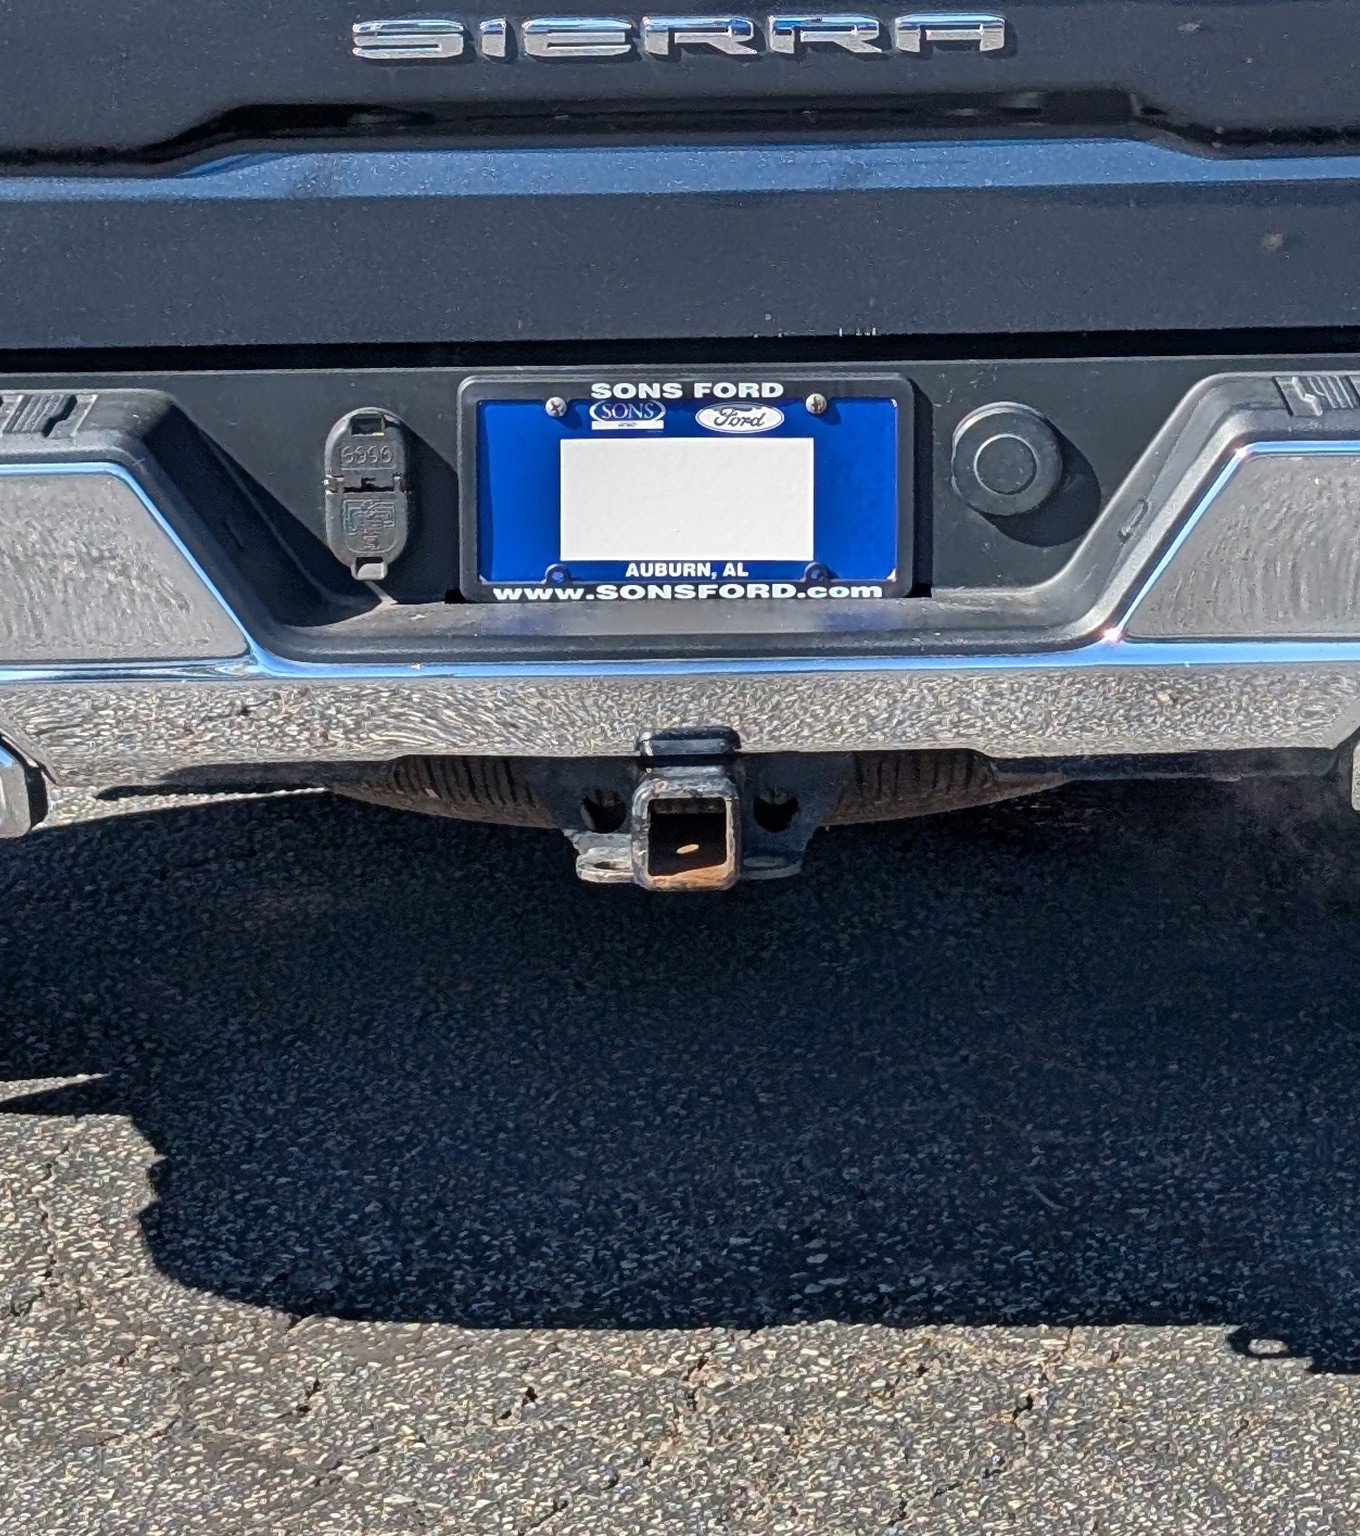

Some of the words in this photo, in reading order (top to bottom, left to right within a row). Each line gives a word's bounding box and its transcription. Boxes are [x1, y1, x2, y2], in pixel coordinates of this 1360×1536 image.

[350, 13, 1007, 60] SIERRA
[590, 382, 683, 399] SONS
[693, 382, 784, 398] FORD
[601, 403, 654, 419] SONS
[713, 406, 766, 429] Ford
[625, 562, 716, 580] AUBURN,
[723, 562, 749, 577] AL
[493, 583, 882, 600] www.SONSFORD.com
